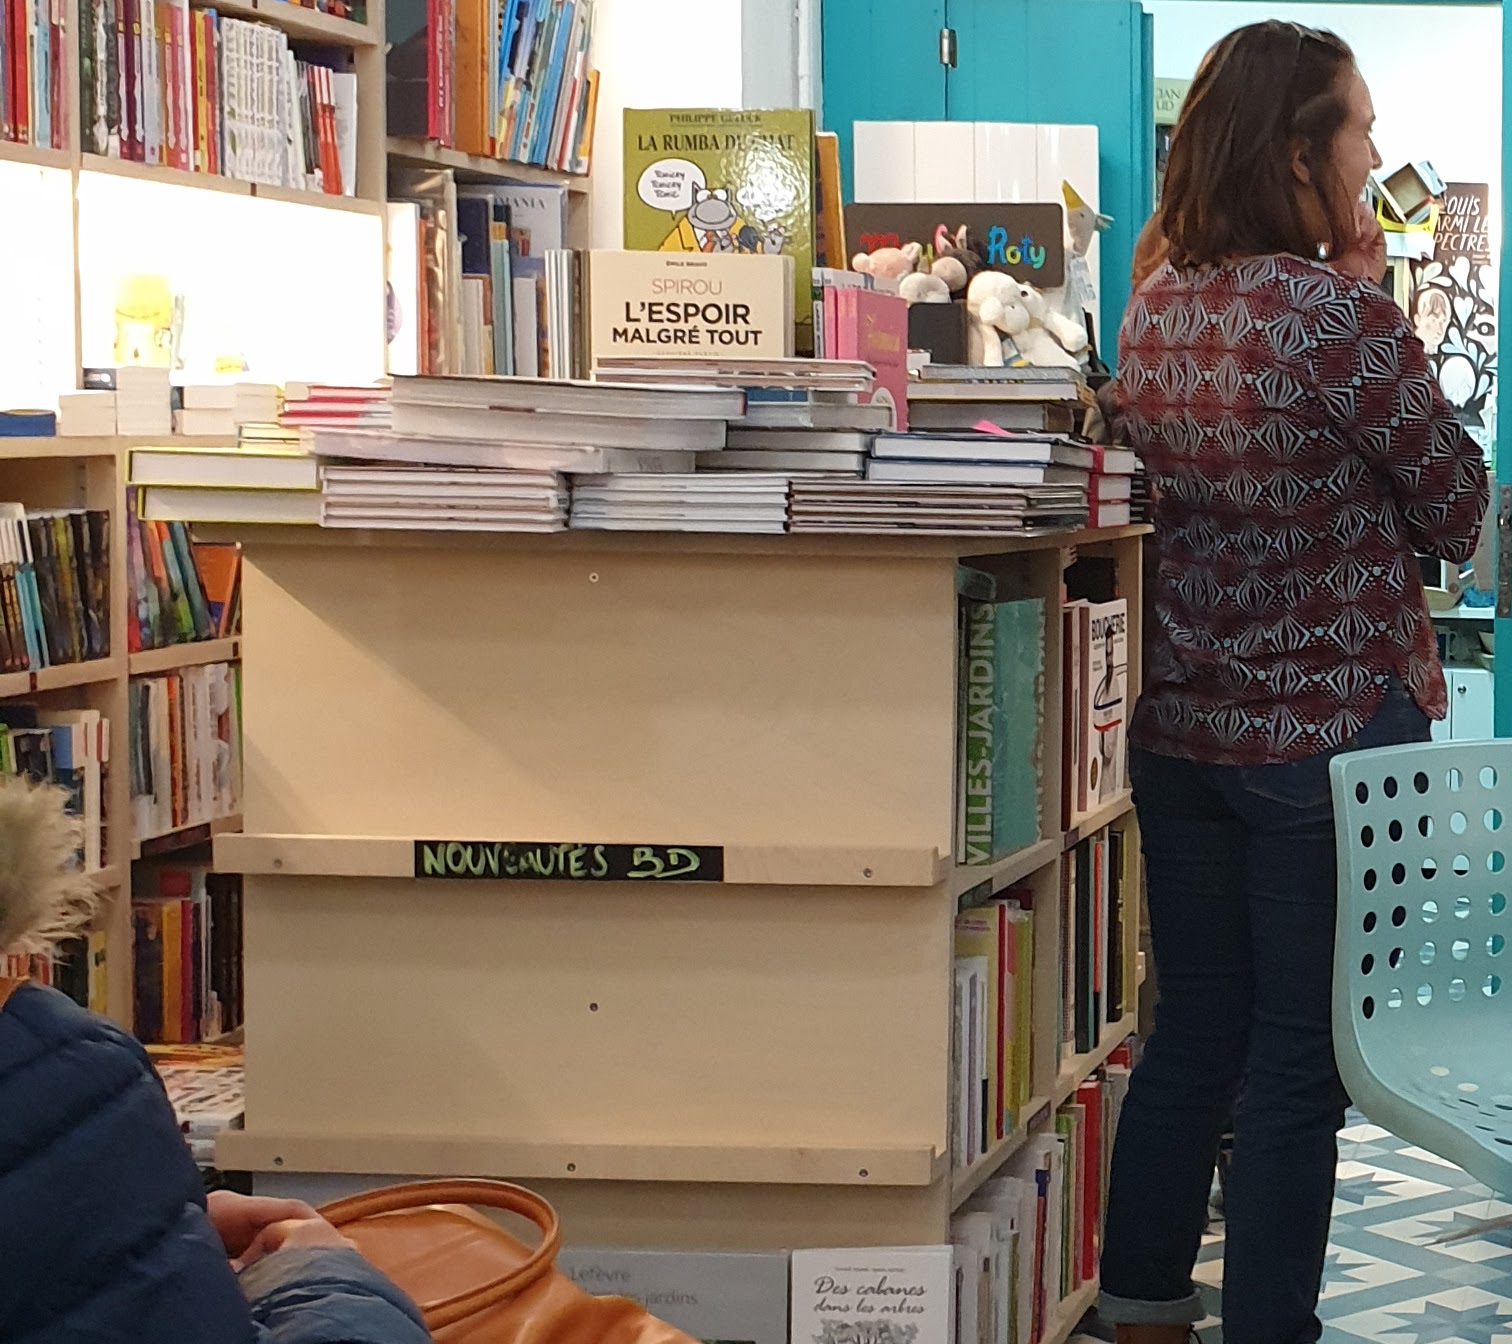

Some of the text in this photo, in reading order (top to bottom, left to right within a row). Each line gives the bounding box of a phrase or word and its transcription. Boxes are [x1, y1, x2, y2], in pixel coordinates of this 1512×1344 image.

[638, 134, 657, 152] LA
[663, 134, 720, 152] RUMBA
[986, 225, 1046, 269] Roty
[1434, 232, 1490, 252] PECTRE
[652, 277, 723, 296] SPIROU
[625, 301, 751, 326] L'ESPOIR
[612, 324, 763, 347] MALGRÉ TOUT
[966, 603, 996, 868] VILLES-JARDINS
[626, 847, 701, 879] BD
[813, 1275, 928, 1297] Des cabanes
[813, 1296, 926, 1314] dans les arbres
